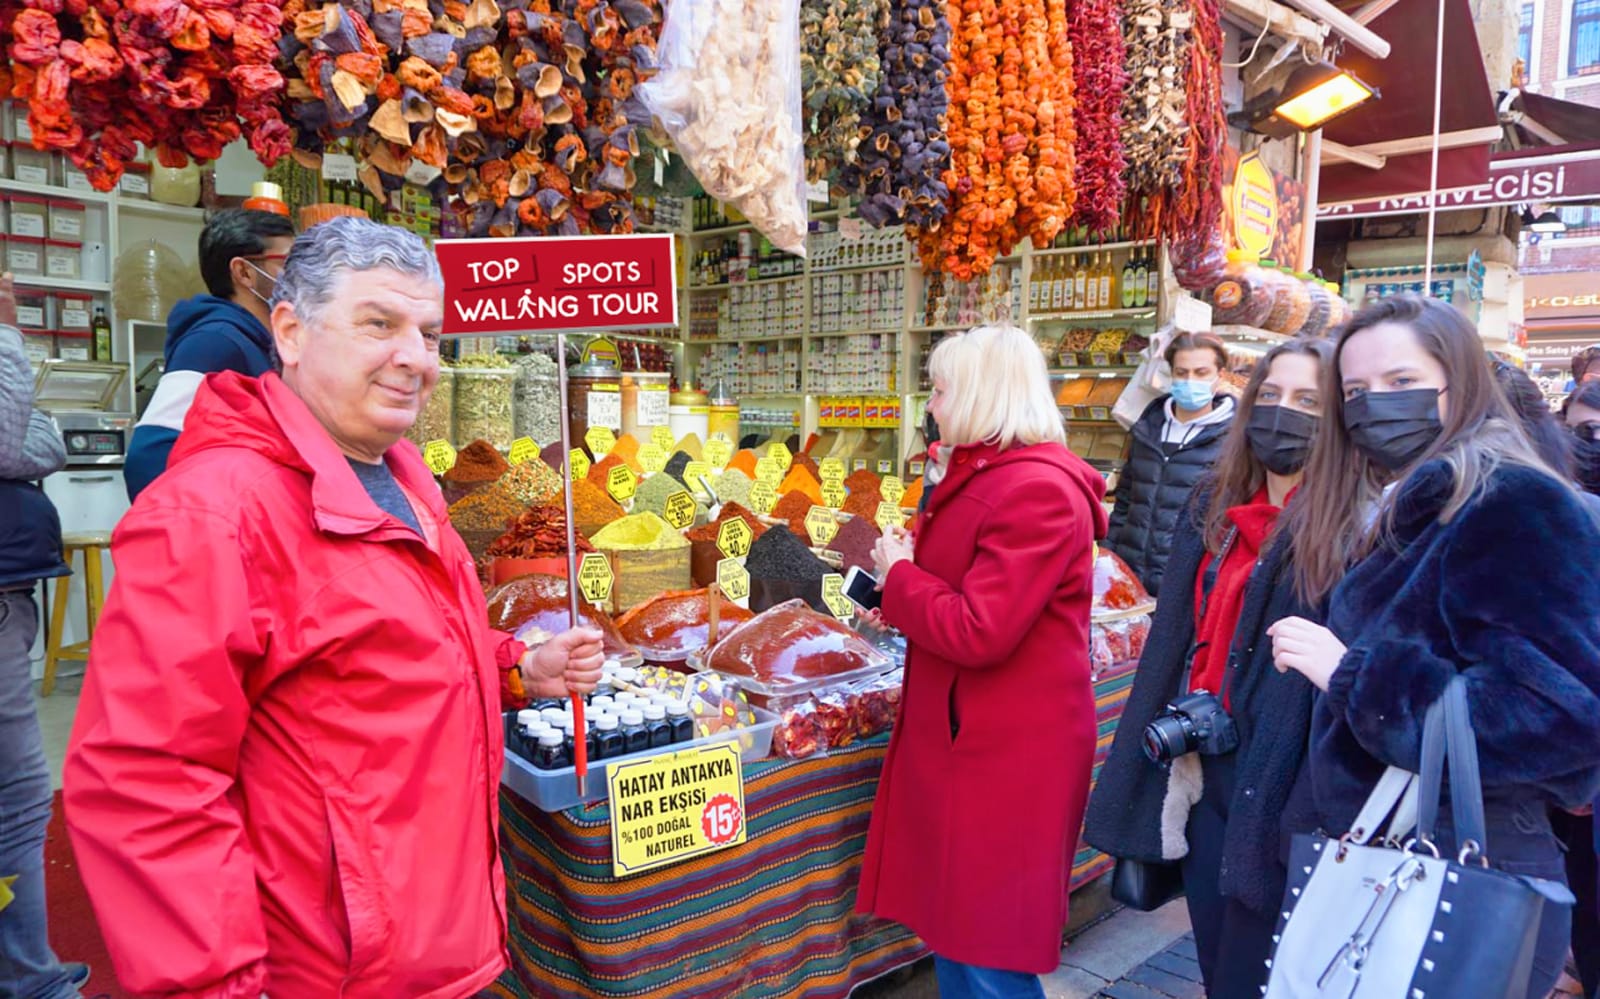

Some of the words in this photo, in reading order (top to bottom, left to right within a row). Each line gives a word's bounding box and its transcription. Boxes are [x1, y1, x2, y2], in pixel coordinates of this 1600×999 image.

[467, 258, 520, 283] TOP
[562, 261, 641, 284] SPOTS
[587, 292, 659, 316] TOUR
[619, 771, 665, 799] HATAY
[671, 758, 733, 788] ANTAKYA
[621, 799, 654, 823] NAR
[621, 825, 654, 845] %100
[656, 815, 692, 835] DOĞAL
[646, 833, 696, 858] NATUREL
